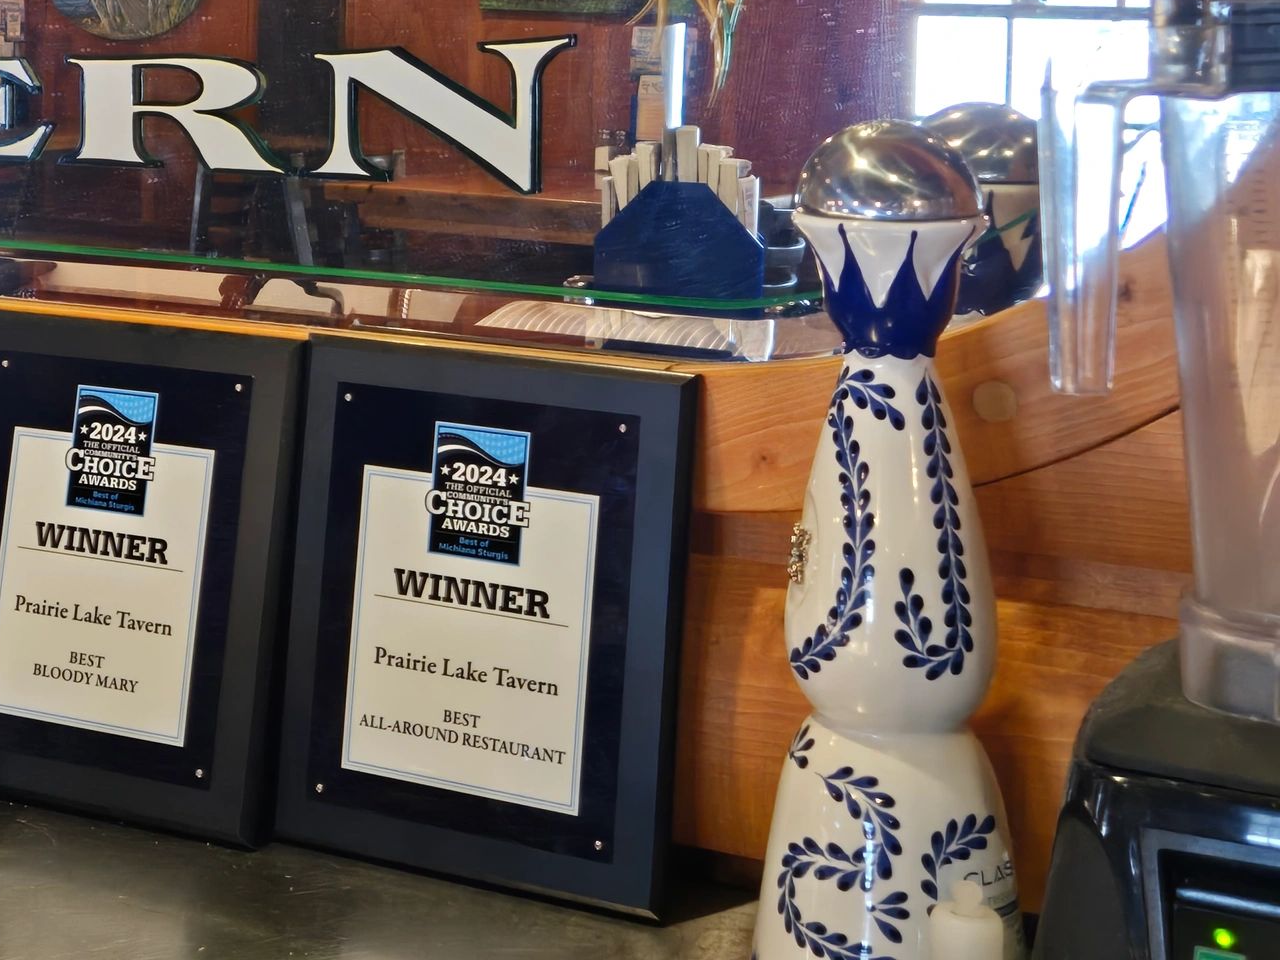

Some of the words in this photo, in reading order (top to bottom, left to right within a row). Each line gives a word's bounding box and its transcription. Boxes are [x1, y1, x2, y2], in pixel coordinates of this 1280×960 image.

[89, 422, 137, 443] 2024
[83, 440, 99, 449] THE
[101, 442, 140, 453] OFFICIAL
[66, 448, 156, 481] CHOICE
[451, 462, 507, 487] 2024
[78, 474, 137, 490] AWARDS
[445, 482, 464, 491] THE
[466, 484, 512, 498] OFFICIAL
[93, 491, 109, 499] Best
[447, 491, 509, 505] COMMUNITY'S
[108, 501, 135, 511] Sturgis
[425, 489, 531, 528] CHOICE
[441, 518, 510, 538] AWARDS
[35, 521, 169, 565] WINNER
[438, 543, 476, 554] Michiana
[477, 548, 509, 560] Sturgis
[459, 537, 477, 546] Best
[394, 568, 551, 619] WINNER
[14, 595, 69, 619] Prairie
[72, 603, 112, 626] Lake
[117, 611, 173, 636] Tavern
[69, 651, 105, 668] BEST
[33, 663, 94, 685] BLOODY
[95, 674, 139, 693] MARY
[373, 646, 437, 674] Prairie
[441, 658, 488, 683] Lake
[493, 667, 559, 696] Tavern
[443, 709, 481, 728] BEST
[359, 713, 459, 744] ALL-AROUND
[461, 732, 566, 765] RESTAURANT
